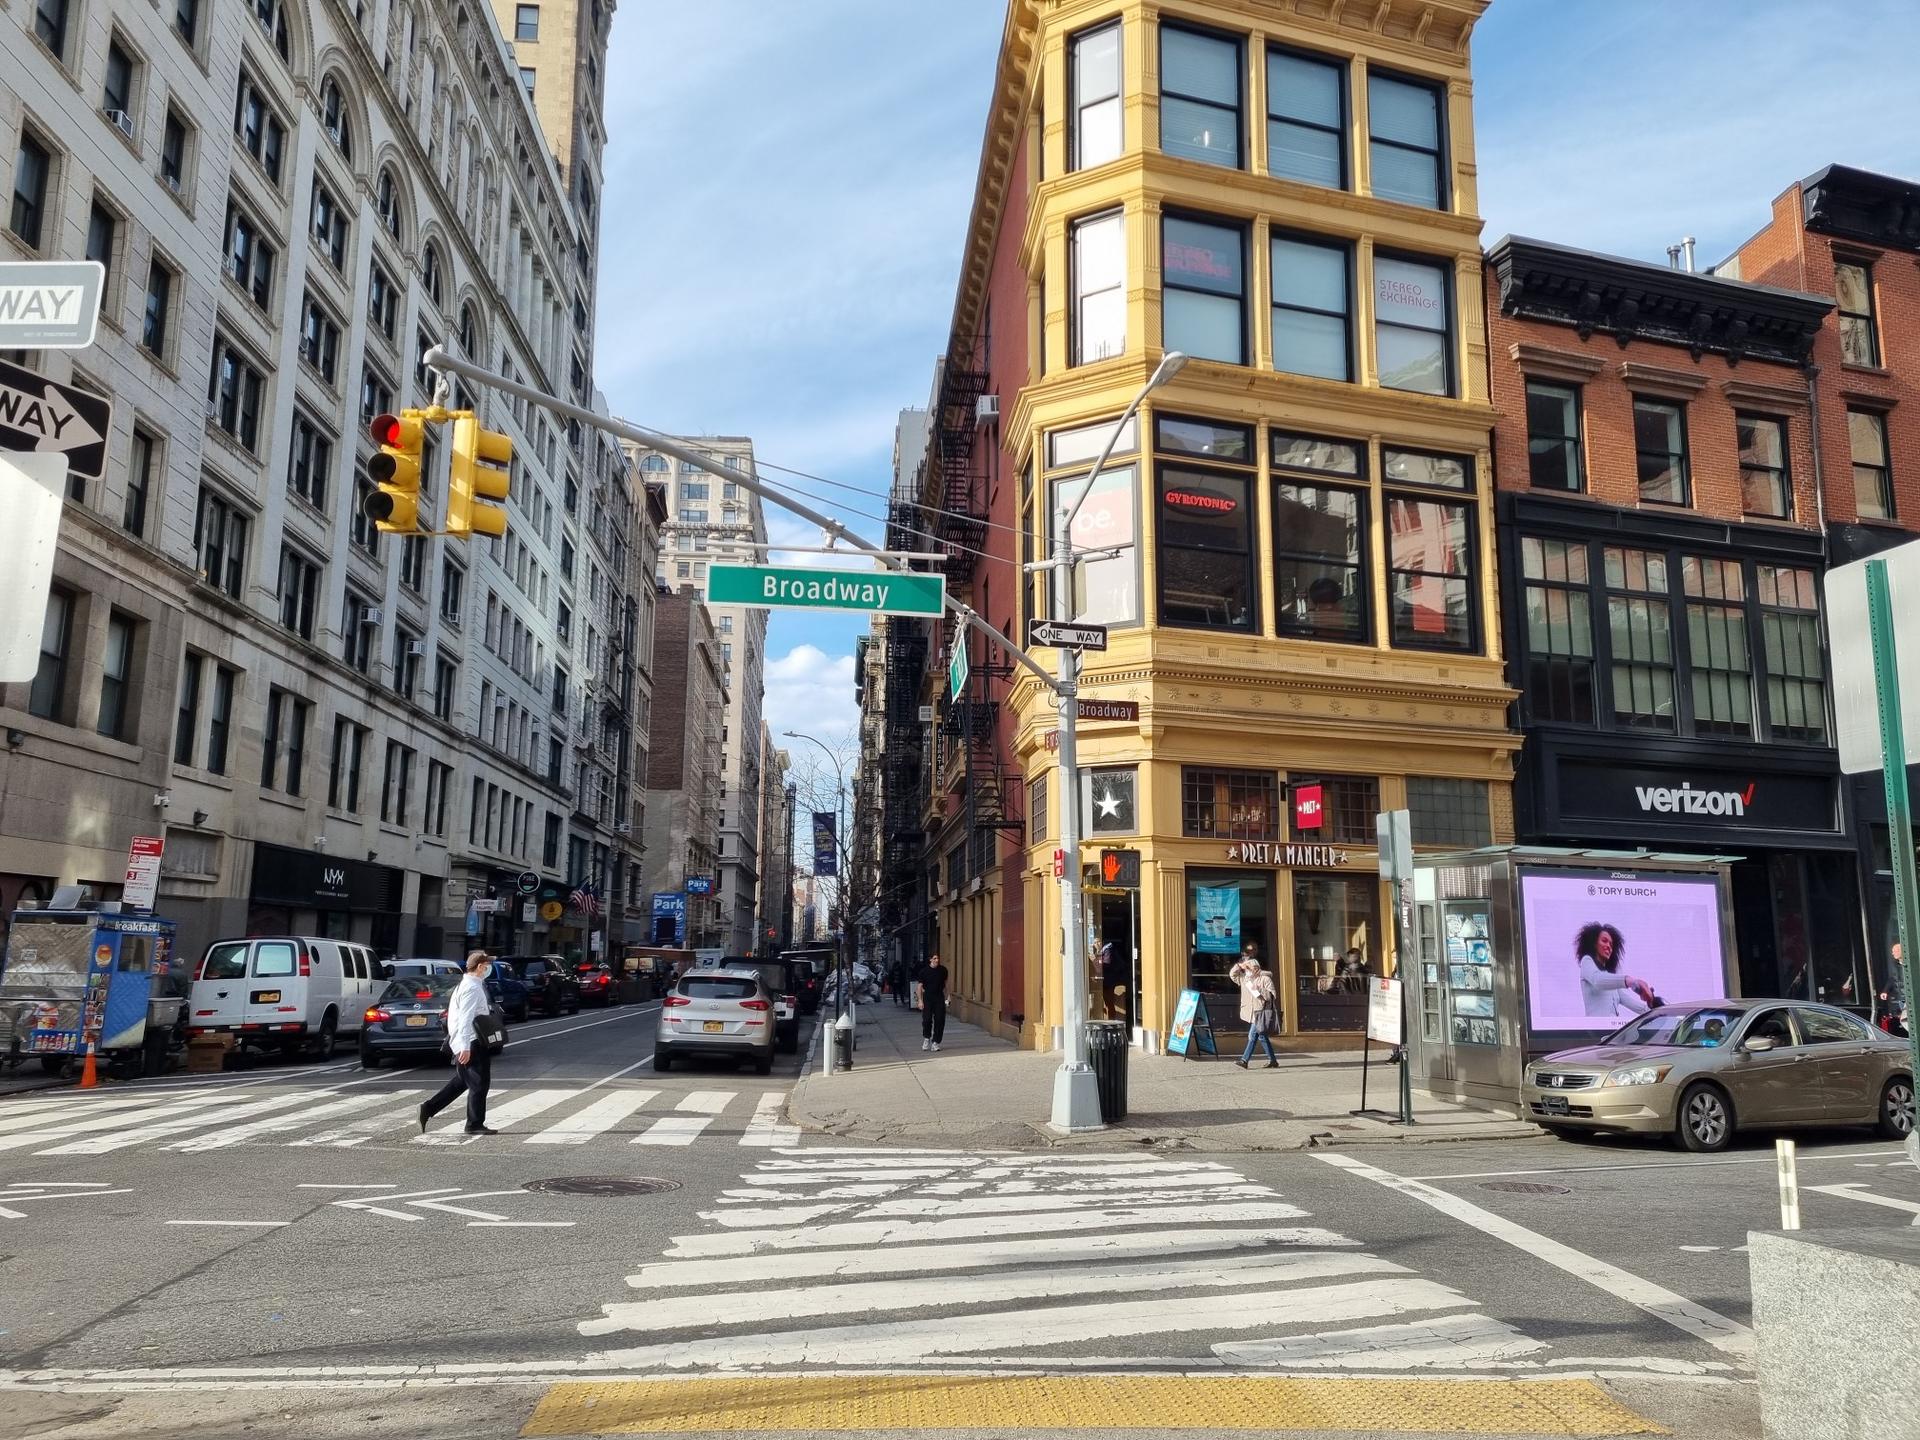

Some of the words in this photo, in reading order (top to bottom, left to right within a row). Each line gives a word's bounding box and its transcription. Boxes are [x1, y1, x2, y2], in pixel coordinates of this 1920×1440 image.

[1380, 280, 1422, 296] STEREO
[0, 290, 75, 320] WAY
[1380, 291, 1439, 309] EXCHANGE
[0, 390, 75, 440] WAY
[763, 575, 889, 609] Broadway
[1040, 628, 1063, 640] ONE
[1076, 632, 1100, 643] WAY
[1079, 703, 1132, 720] Broadway
[1303, 800, 1316, 814] PRET
[1635, 782, 1744, 816] verizon
[1241, 843, 1270, 864] PRET
[1273, 845, 1281, 865] A
[1286, 846, 1337, 867] MANGER
[323, 867, 345, 886] NYX
[688, 880, 709, 888] Park
[1597, 886, 1623, 896] TORY
[1624, 887, 1657, 897] BURCH
[653, 898, 684, 910] Park
